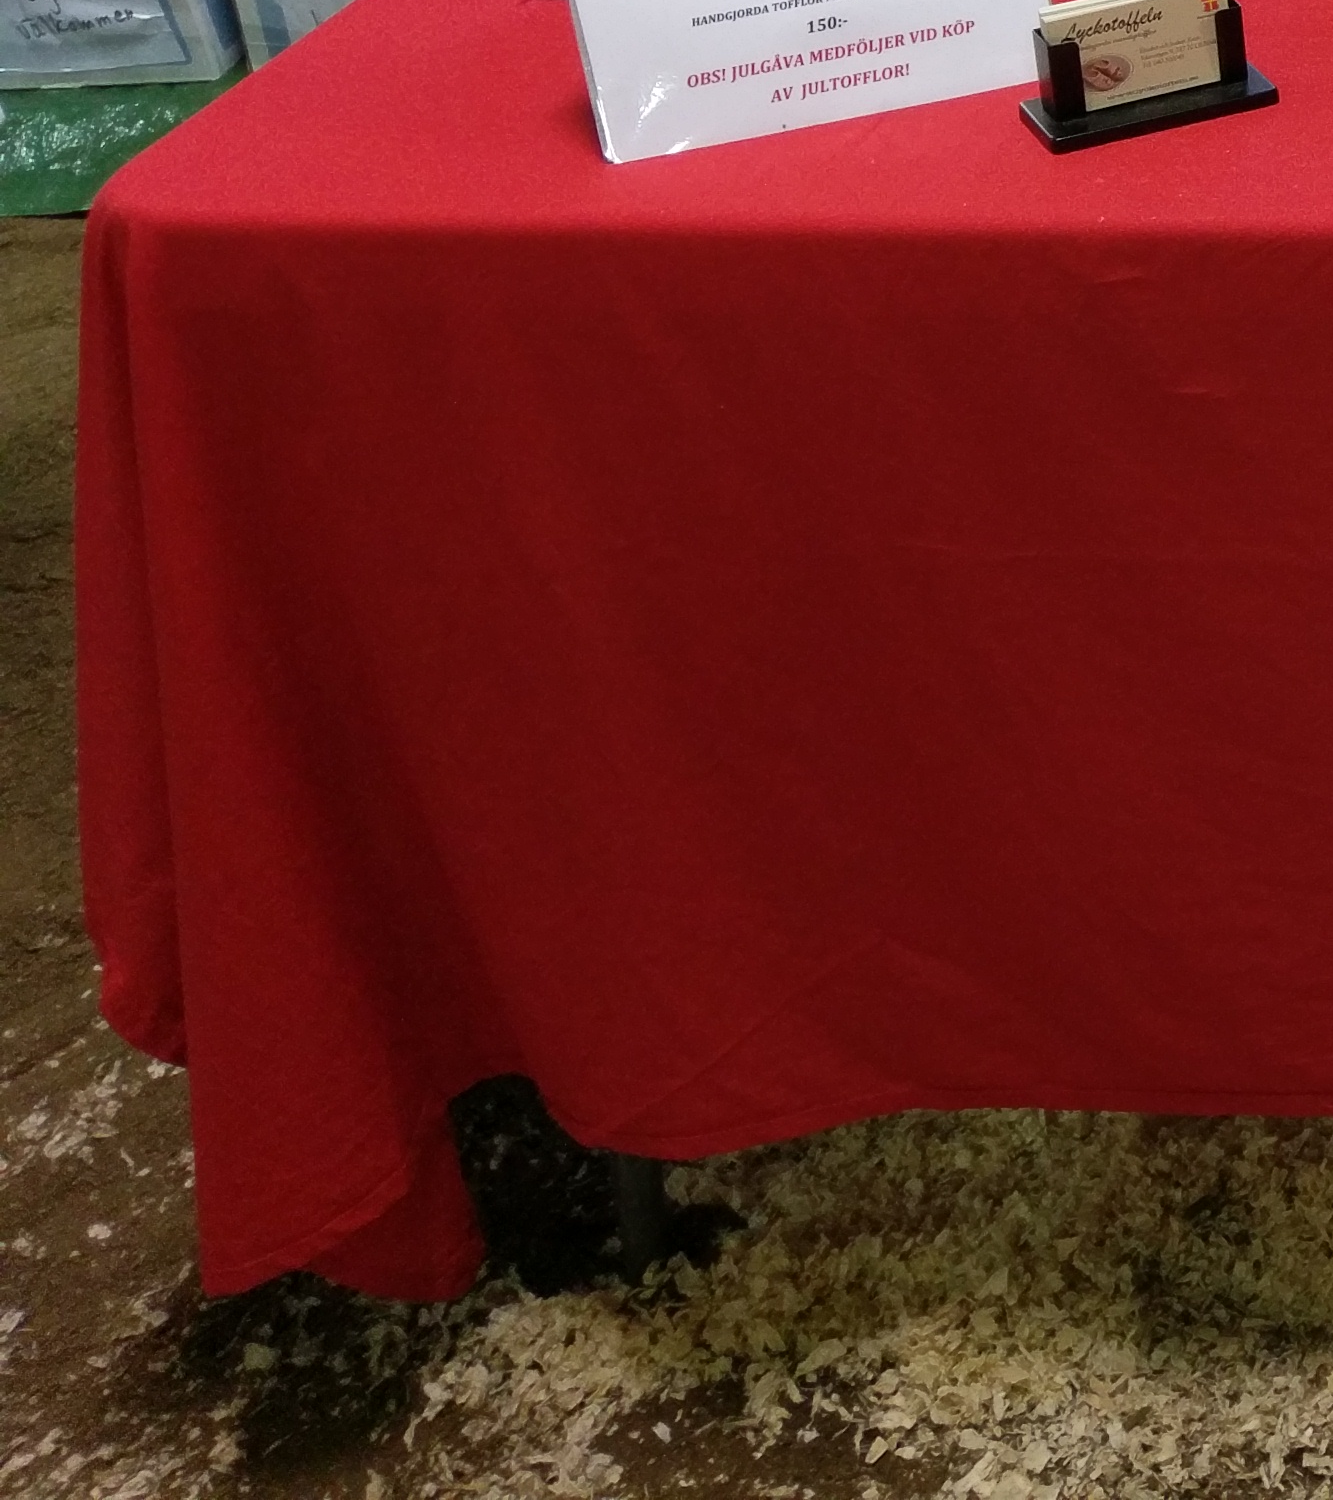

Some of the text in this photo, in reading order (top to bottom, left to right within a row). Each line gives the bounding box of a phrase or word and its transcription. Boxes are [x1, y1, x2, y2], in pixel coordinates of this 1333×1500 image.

[692, 4, 769, 27] HANDGJORDA
[807, 16, 848, 34] 150:-
[1061, 6, 1163, 44] Lyckotoffeln
[687, 19, 976, 88] OBS! JULGÅVA MEDFÖLJER VID KÖP
[770, 63, 911, 103] AV JULTOFFLOR!
